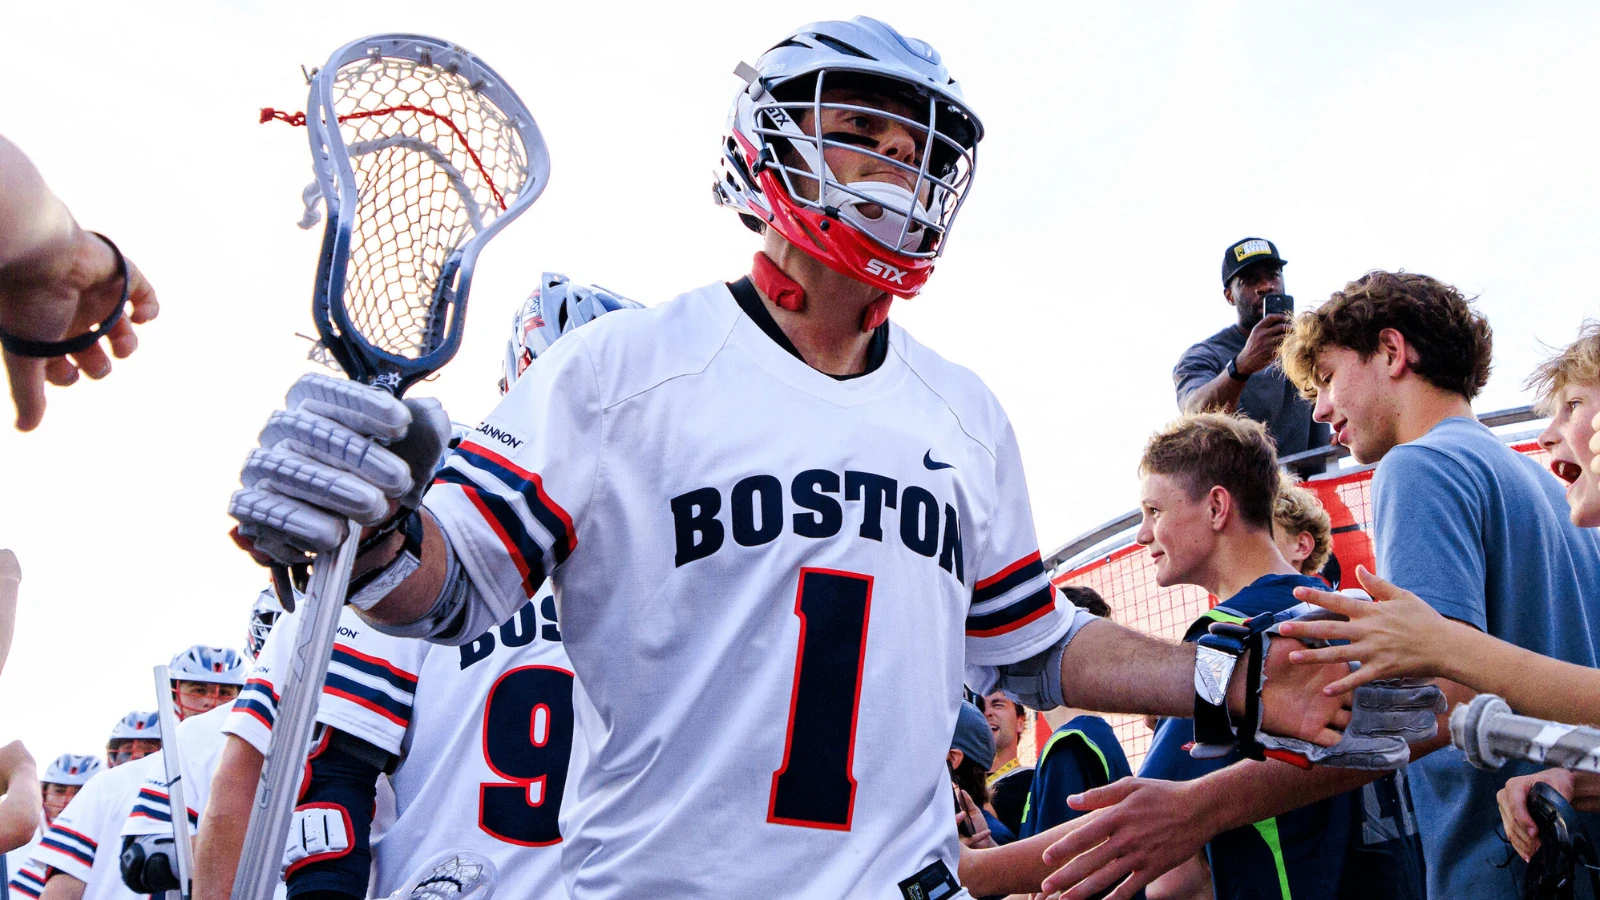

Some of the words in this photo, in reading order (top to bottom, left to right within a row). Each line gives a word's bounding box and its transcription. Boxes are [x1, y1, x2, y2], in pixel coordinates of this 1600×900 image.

[864, 258, 908, 285] STX
[670, 469, 965, 587] BOSTON
[479, 664, 574, 848] 9
[767, 567, 874, 832] 1
